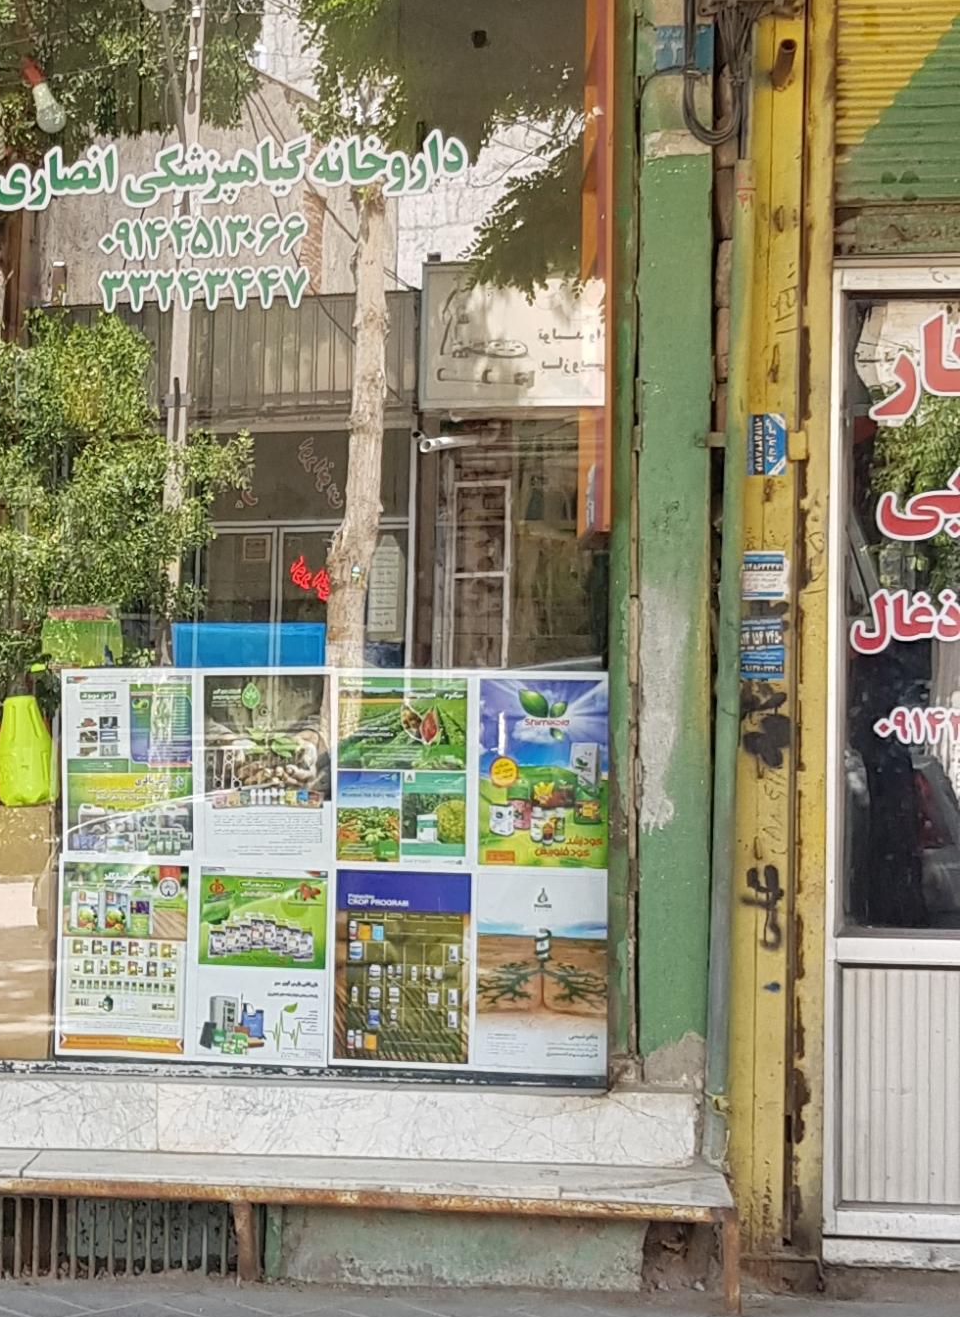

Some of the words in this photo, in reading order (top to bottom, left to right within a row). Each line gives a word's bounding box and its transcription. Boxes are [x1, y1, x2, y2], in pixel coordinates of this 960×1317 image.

[311, 130, 468, 196] داروخانه
[98, 211, 308, 261] ۰۹۱۴۴۵۱۳۰۶۶
[98, 266, 309, 314] ۳۳۲۴۳۴۴۷
[850, 588, 960, 654] ذغال
